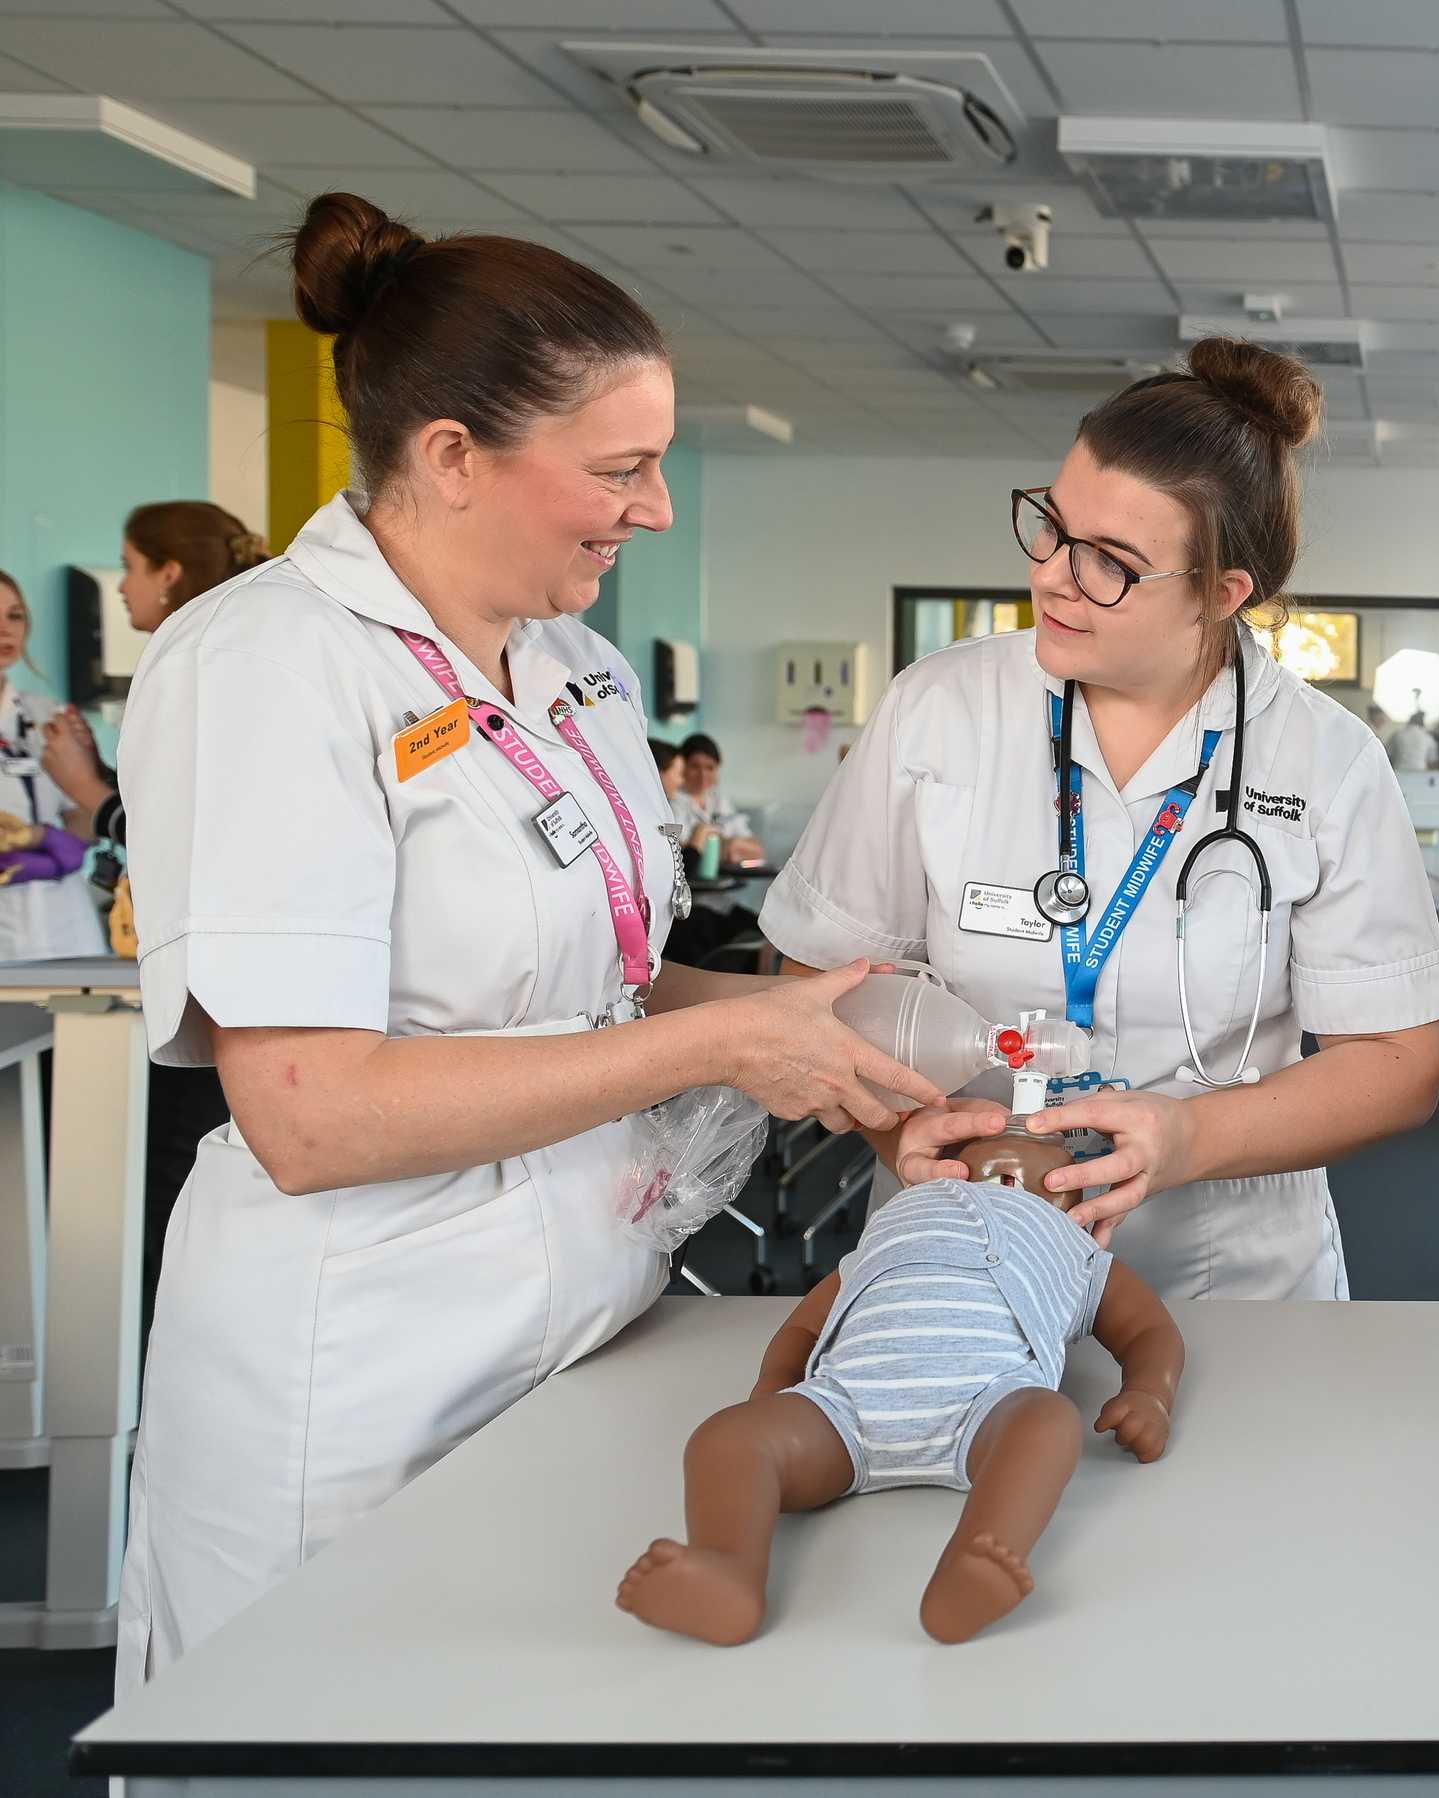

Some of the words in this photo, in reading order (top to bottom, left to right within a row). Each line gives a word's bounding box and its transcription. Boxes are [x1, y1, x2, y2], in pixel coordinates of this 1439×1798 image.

[409, 734, 430, 753] 2nd
[433, 719, 458, 738] Year
[493, 727, 560, 797] STUDE
[1244, 801, 1255, 812] of
[1257, 804, 1301, 821] Suffolk
[1245, 786, 1307, 811] University
[592, 840, 635, 917] IDWIFE
[1086, 898, 1131, 969] STUDENT
[1123, 835, 1165, 898] MIDWIFE
[1020, 918, 1046, 928] Taylor
[1067, 923, 1081, 963] WIFE
